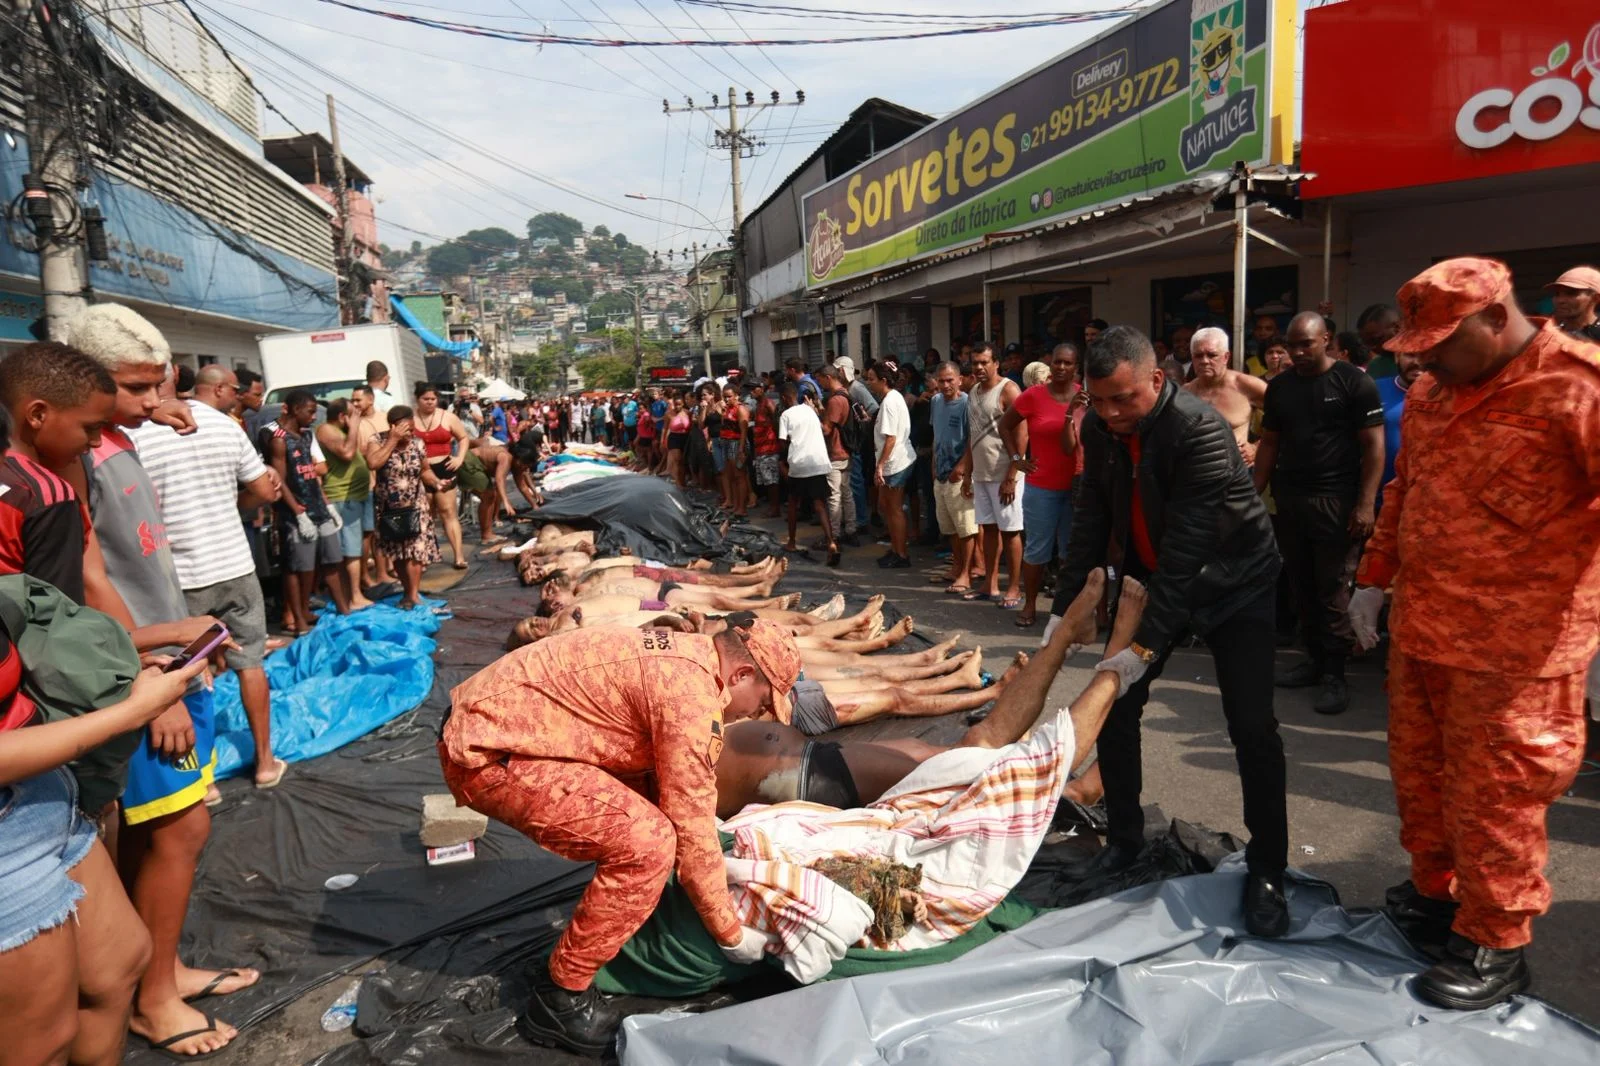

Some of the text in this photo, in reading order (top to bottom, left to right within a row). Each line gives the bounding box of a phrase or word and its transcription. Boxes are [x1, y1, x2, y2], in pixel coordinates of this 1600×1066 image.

[1076, 58, 1122, 90] Delivery
[1031, 57, 1180, 148] 21 99134-9772
[1187, 98, 1249, 162] NATUICE
[846, 112, 1016, 235] Sorvetes
[1055, 158, 1166, 204] @natuicevilacruzeiro
[915, 197, 1016, 246] Direto da fábrica
